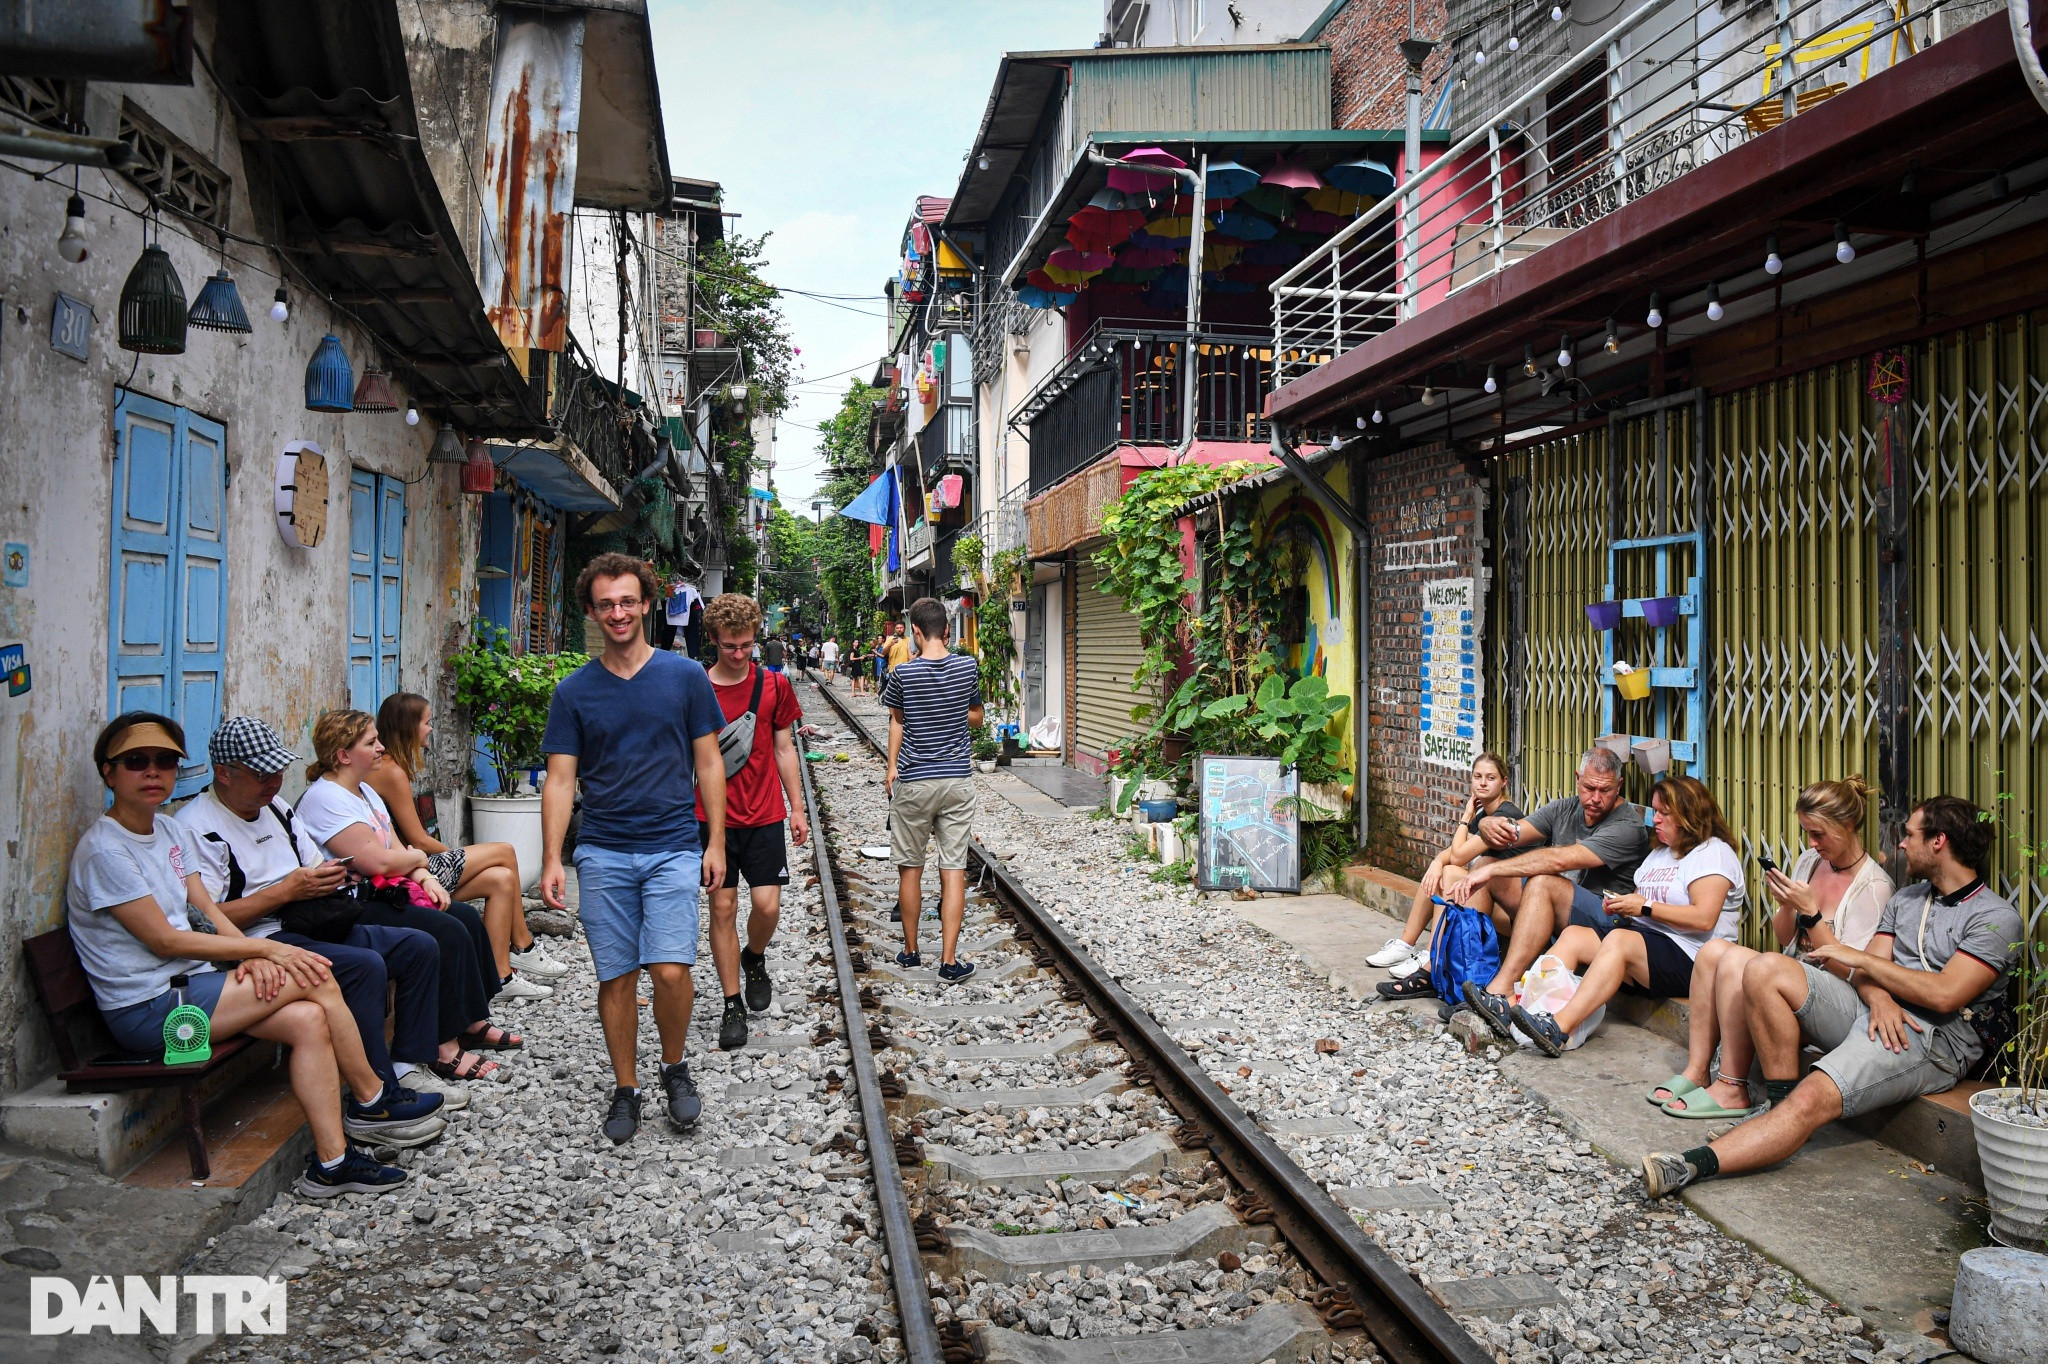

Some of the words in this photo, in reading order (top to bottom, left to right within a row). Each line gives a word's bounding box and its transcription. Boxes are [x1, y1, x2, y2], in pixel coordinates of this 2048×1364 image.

[61, 308, 85, 348] 30
[1428, 586, 1467, 606] WELCOME
[1014, 602, 1024, 611] 37
[1, 654, 22, 673] VISA
[1424, 733, 1448, 759] SAFE
[1449, 738, 1472, 767] HERE
